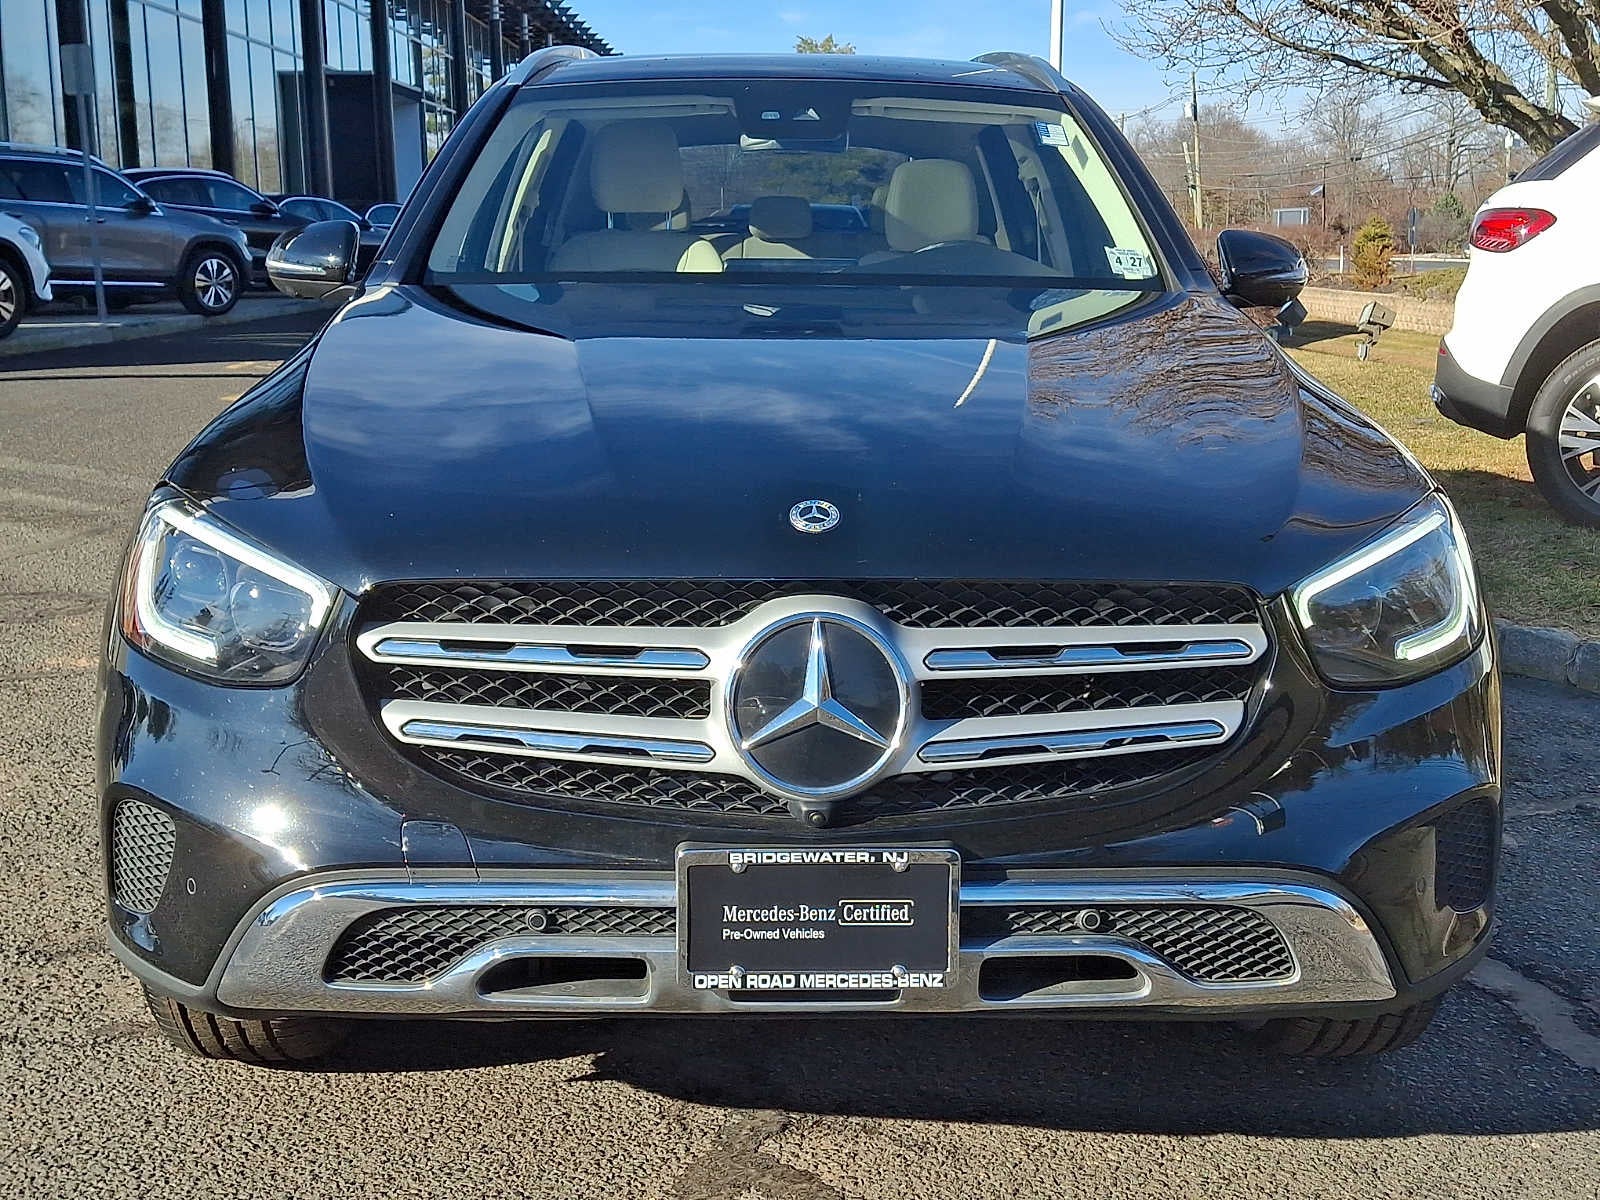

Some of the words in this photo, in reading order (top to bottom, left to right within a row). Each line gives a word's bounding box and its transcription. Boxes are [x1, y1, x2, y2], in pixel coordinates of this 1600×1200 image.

[1115, 256, 1122, 266] 4
[1129, 257, 1142, 267] 27
[729, 852, 876, 864] BRIDGEWATER,
[882, 852, 909, 864] NJ
[722, 905, 836, 922] Mercedes-Benz
[843, 904, 909, 921] Certified
[722, 928, 780, 940] Pre-Owned
[782, 928, 825, 939] Vehicles
[694, 974, 742, 989] OPEN
[746, 974, 796, 989] ROAD
[800, 974, 944, 988] MERCEDES-BENZ
